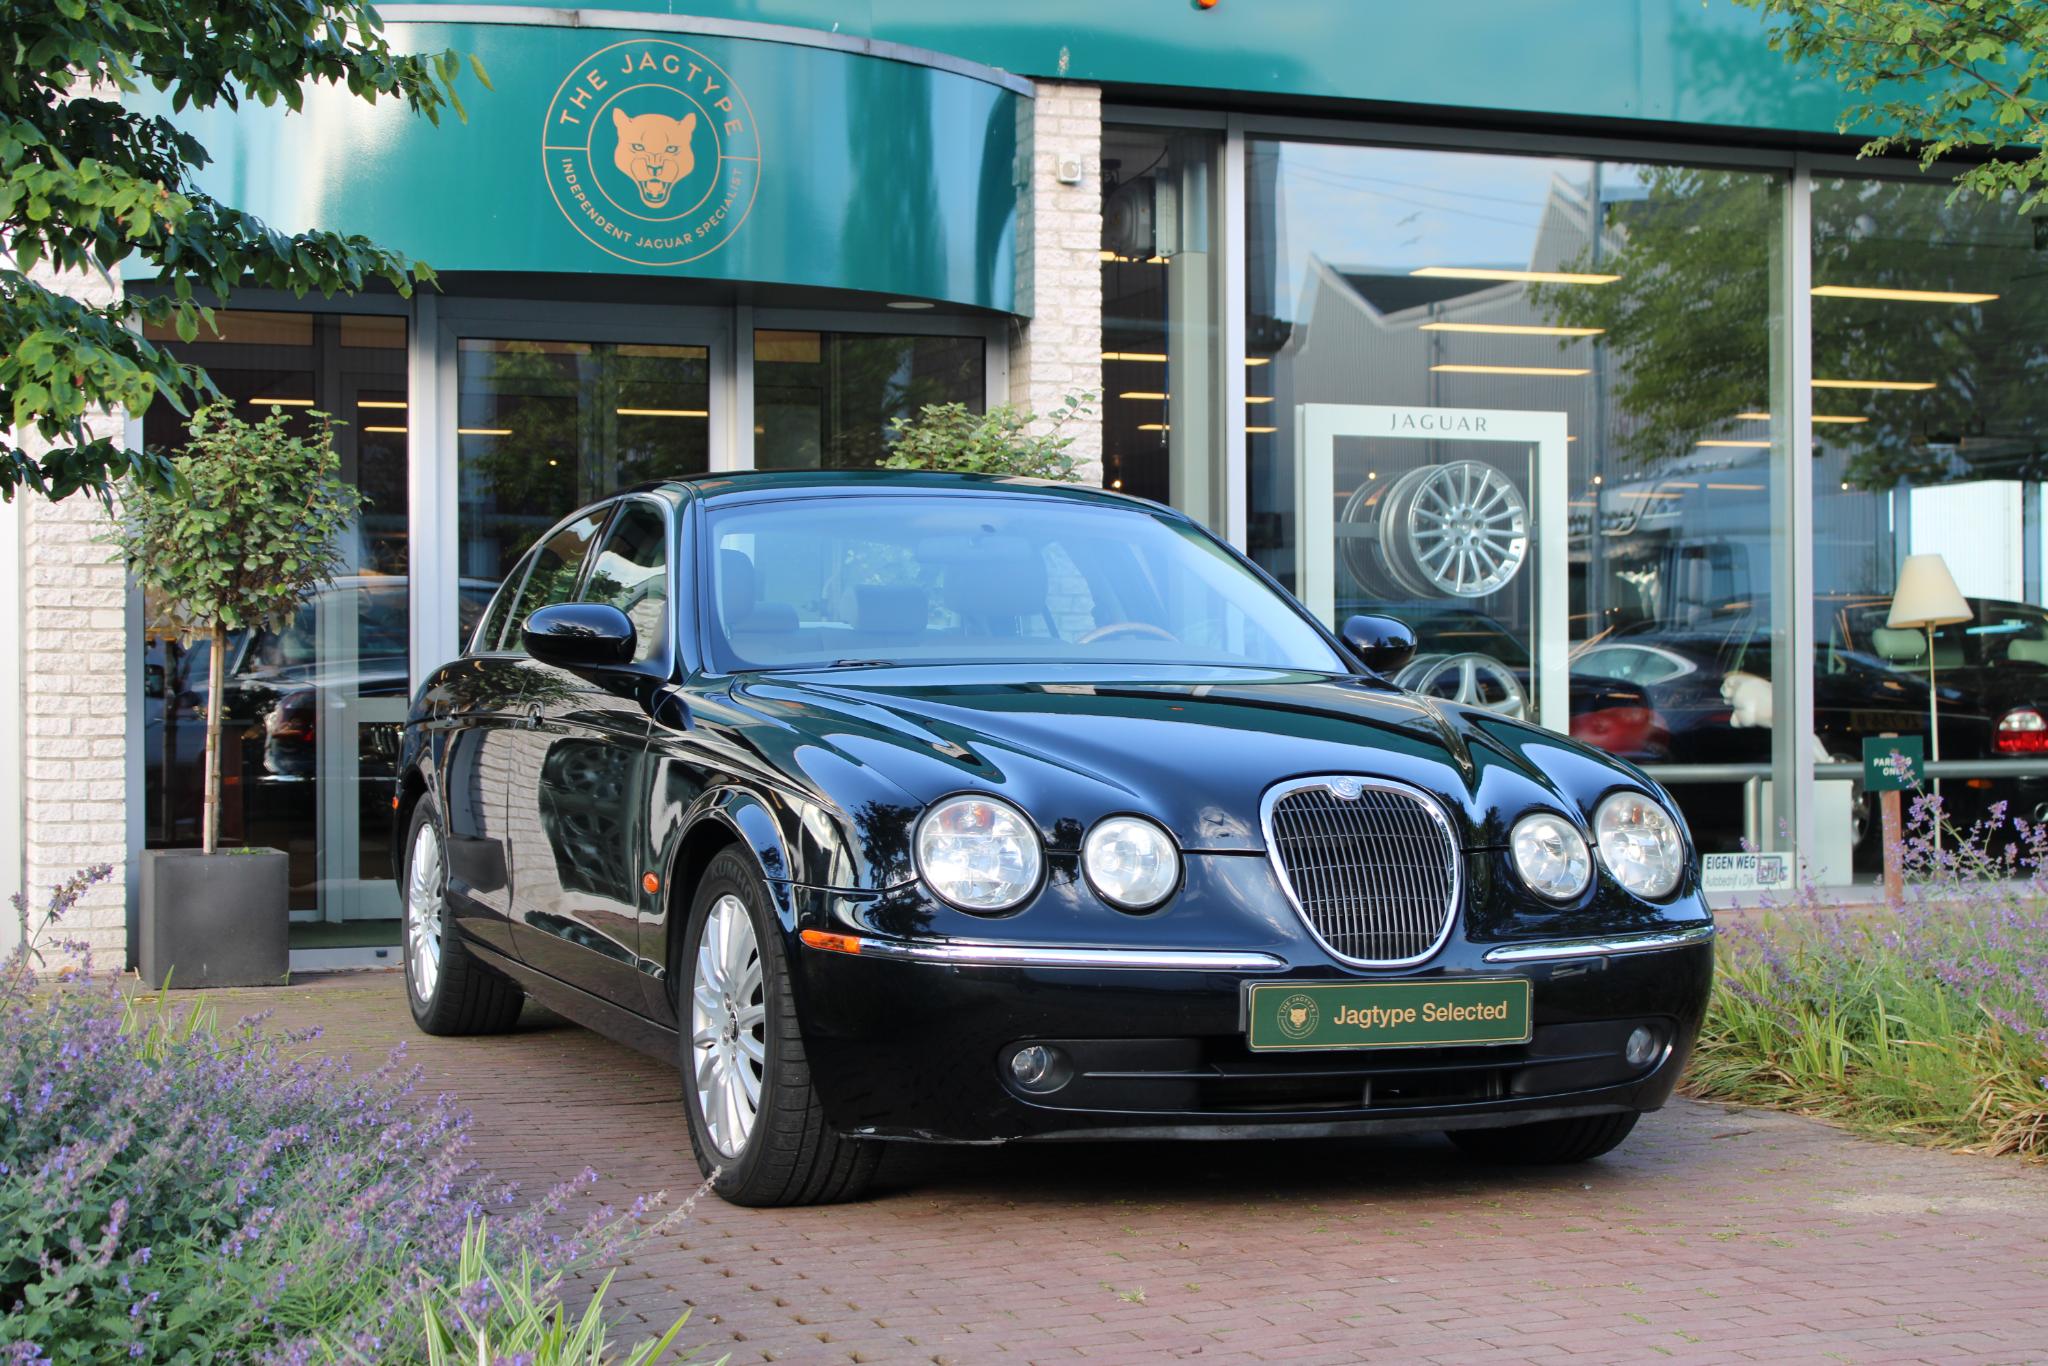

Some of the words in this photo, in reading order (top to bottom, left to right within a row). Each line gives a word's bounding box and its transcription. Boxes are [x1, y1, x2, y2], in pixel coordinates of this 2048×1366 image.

[560, 69, 608, 124] THE
[561, 157, 633, 242] INDEPENDENT
[635, 232, 694, 249] JAGUAR
[695, 168, 744, 238] SPECIALIST
[1391, 413, 1486, 432] JAGUAR
[1873, 757, 1913, 767] PARG
[1706, 856, 1734, 870] EIGEN
[1736, 856, 1756, 869] WEG
[711, 860, 753, 906] KUMHO
[1333, 1004, 1416, 1029] Jagtype
[1422, 1000, 1508, 1022] Selected
